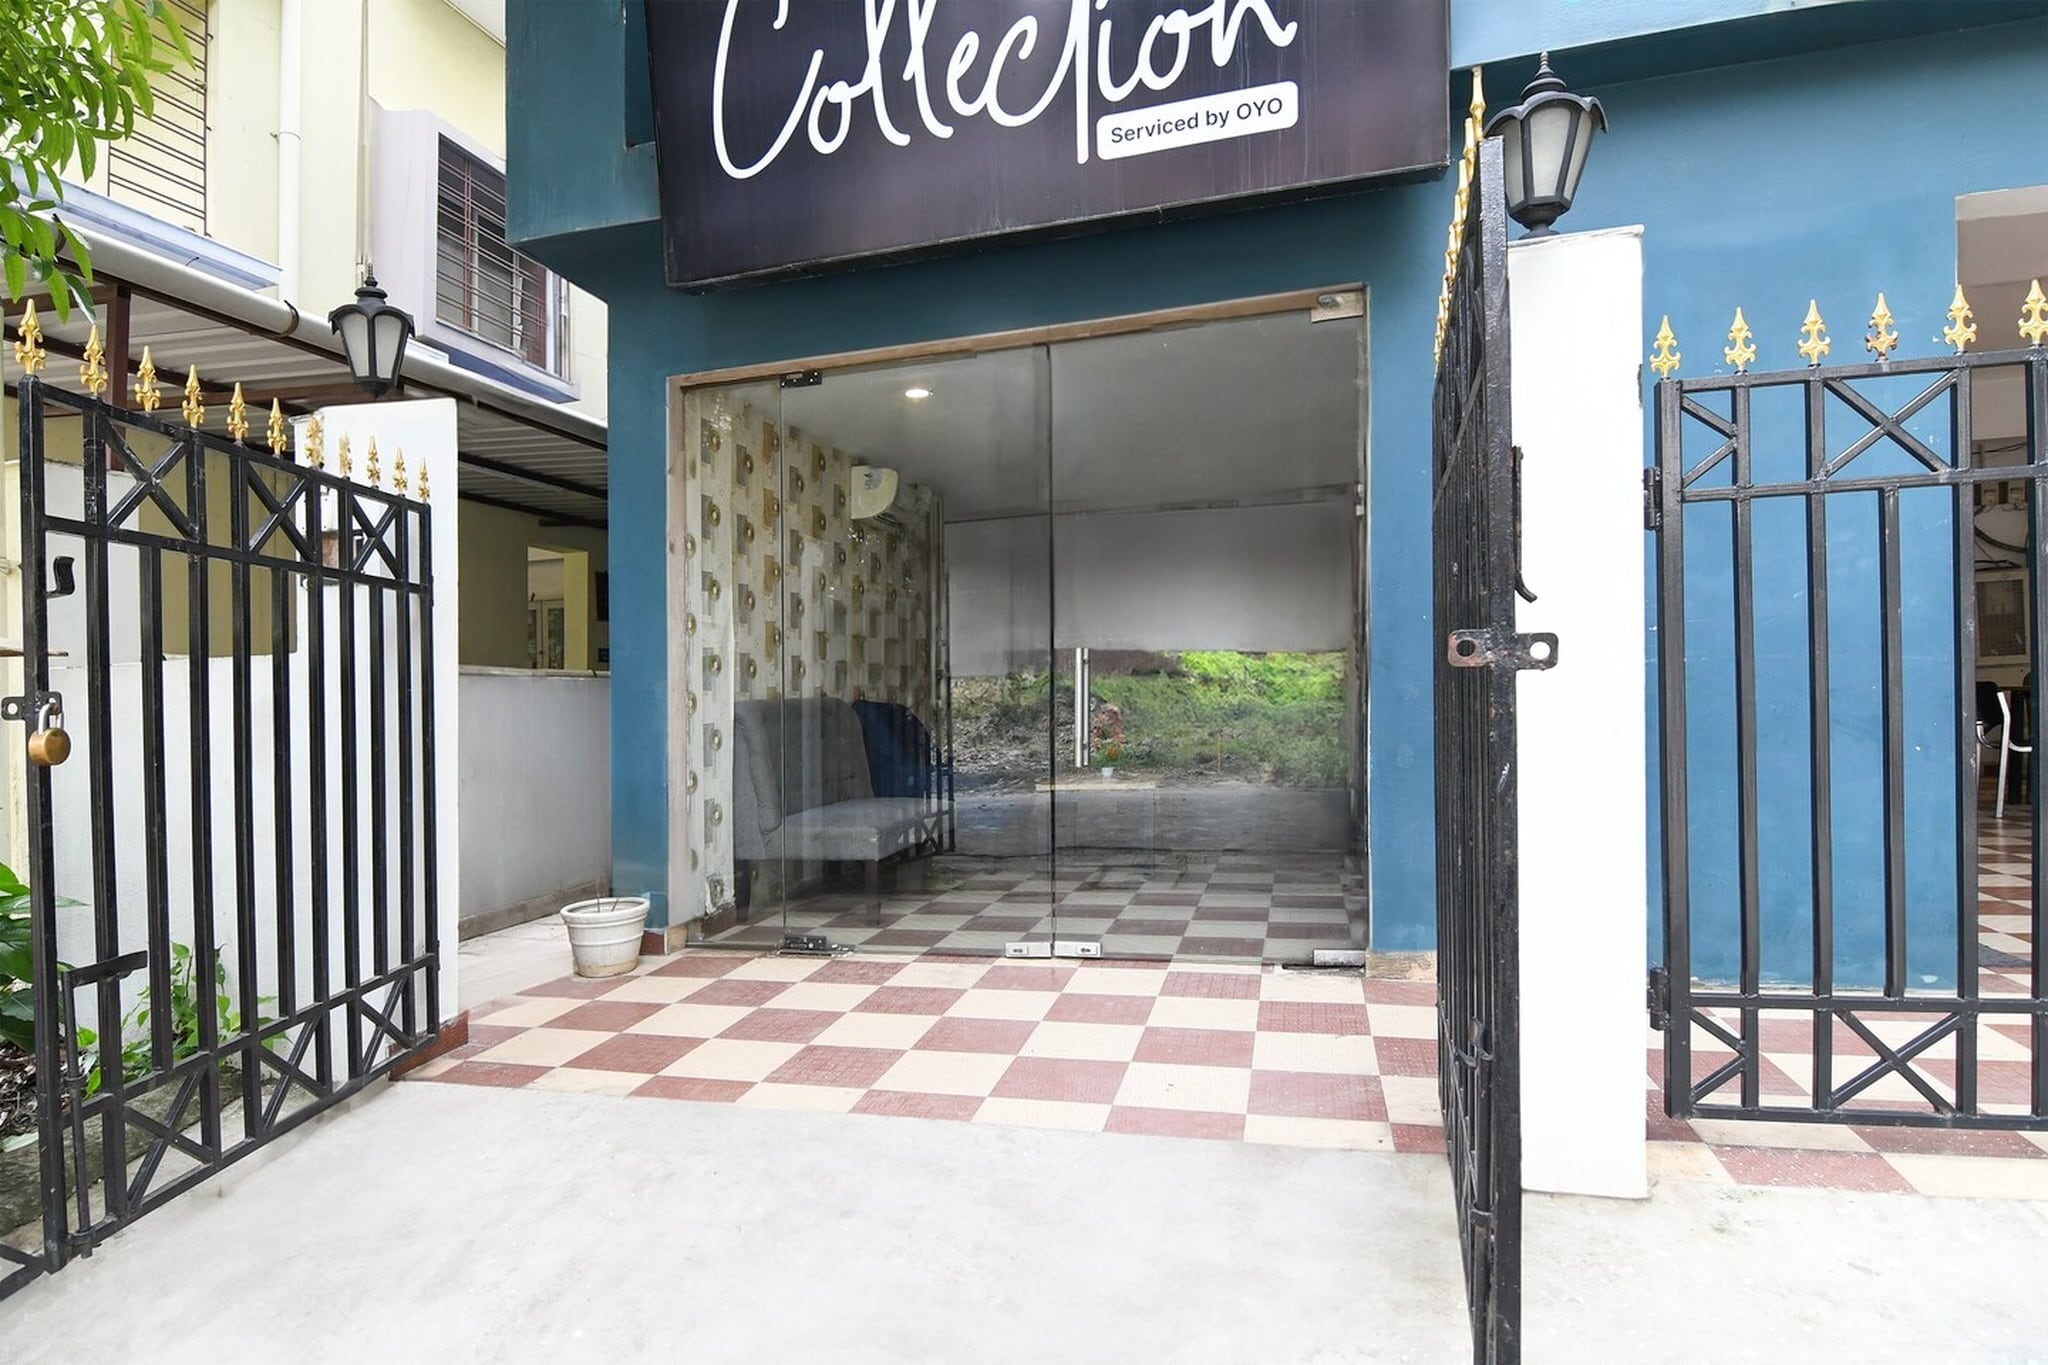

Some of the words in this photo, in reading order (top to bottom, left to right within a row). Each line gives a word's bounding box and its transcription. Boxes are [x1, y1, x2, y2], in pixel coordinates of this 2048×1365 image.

[714, 0, 1298, 178] Collection
[1111, 112, 1199, 143] Serviced
[1206, 110, 1230, 128] by
[1237, 98, 1283, 120] OYO
